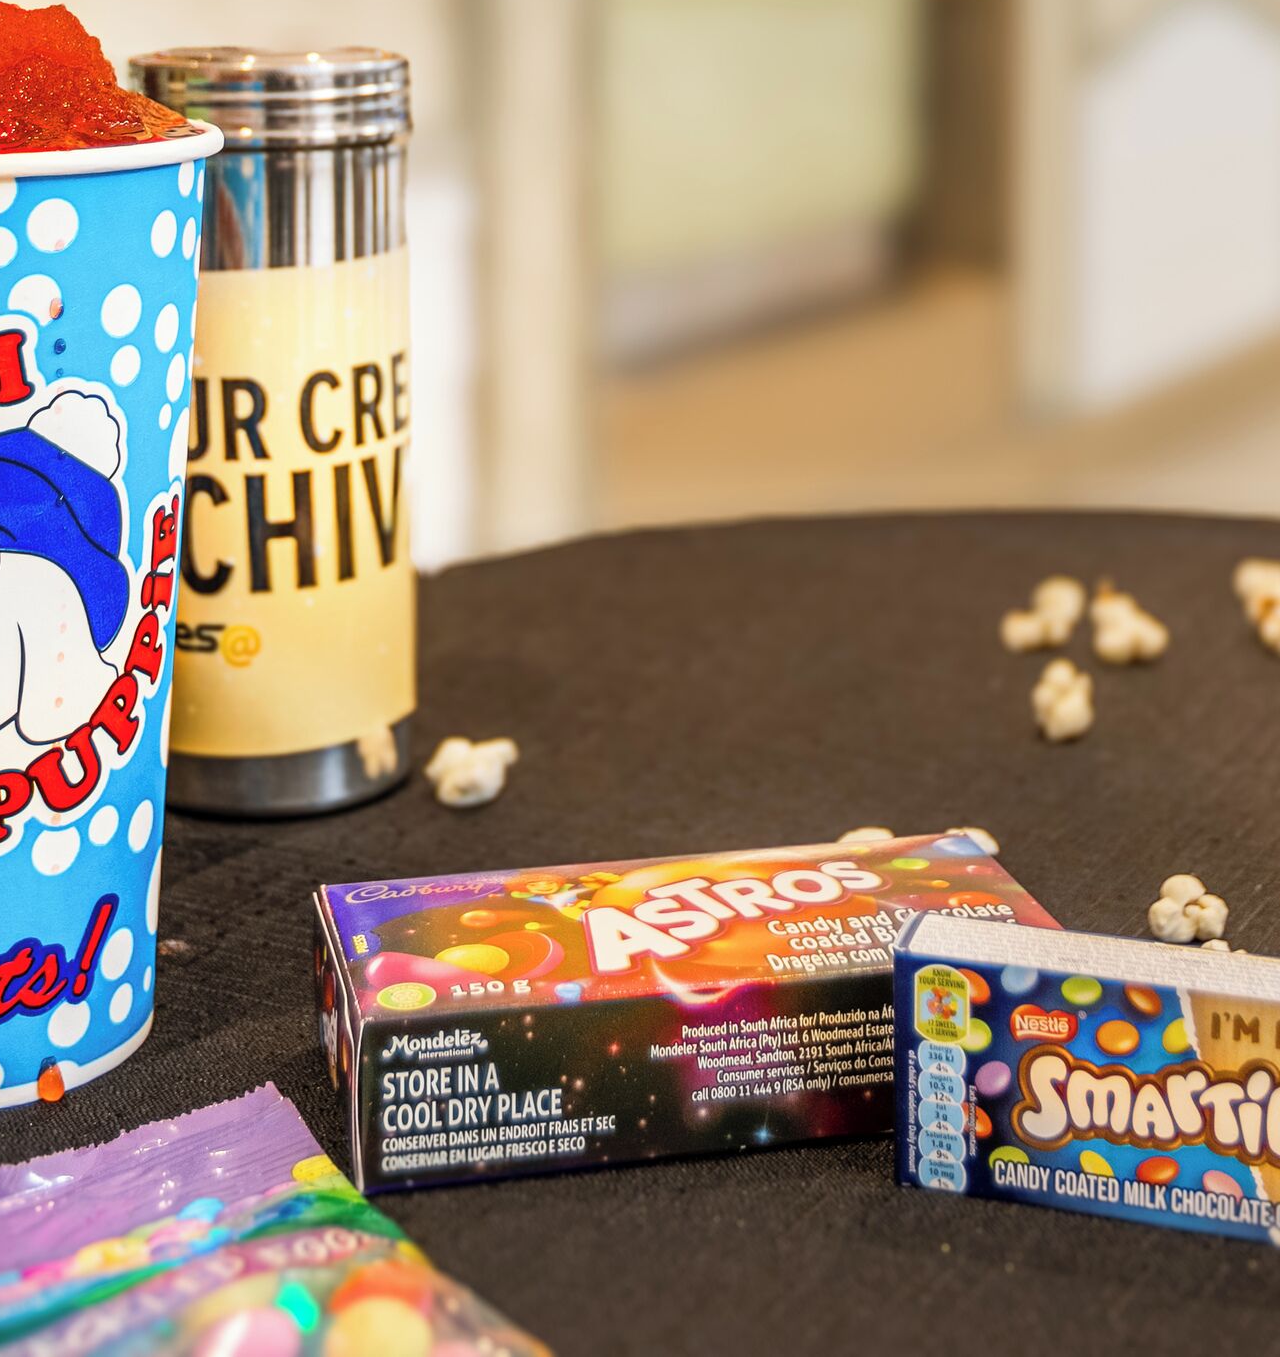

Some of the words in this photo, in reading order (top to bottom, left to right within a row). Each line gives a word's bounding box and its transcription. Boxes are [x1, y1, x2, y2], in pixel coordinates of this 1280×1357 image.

[300, 352, 410, 454] CRE
[181, 445, 406, 596] CHIV
[345, 882, 485, 904] Cadbury
[584, 861, 882, 973] ASTROS
[768, 915, 844, 936] Candy
[847, 910, 893, 930] and
[789, 929, 873, 951] coated
[850, 947, 889, 963] com
[451, 980, 505, 996] 150
[513, 979, 531, 993] g
[919, 976, 936, 985] YOUR
[938, 978, 965, 989] SERVING
[932, 969, 951, 978] KNOW
[682, 1022, 726, 1039] Produced
[729, 1021, 738, 1034] in
[740, 1018, 768, 1033] South
[770, 1015, 797, 1030] Africa
[799, 1013, 817, 1027] for/
[819, 1008, 866, 1025] Produzido
[868, 1010, 879, 1020] na
[1210, 1011, 1261, 1044] I'M
[418, 1046, 474, 1060] International
[651, 1043, 697, 1058] Mondelez
[700, 1039, 727, 1053] South
[729, 1036, 756, 1050] Africa
[758, 1032, 781, 1049] (Pty)
[783, 1031, 800, 1045] Ltd.
[802, 1030, 809, 1042] 6
[811, 1025, 863, 1043] Woodmead
[866, 1023, 894, 1037] Estate
[698, 1051, 753, 1070] Woodmead,
[755, 1049, 797, 1063] Sandton,
[799, 1045, 823, 1059] 2191
[825, 1041, 852, 1057] South
[717, 1069, 764, 1083] Consumer
[767, 1063, 804, 1078] services
[813, 1059, 852, 1074] Serviços
[854, 1056, 866, 1069] do
[383, 1067, 452, 1100] STORE
[458, 1064, 478, 1092] IN
[484, 1062, 500, 1090] A
[692, 1087, 709, 1101] call
[711, 1085, 736, 1099] 0800
[739, 1085, 750, 1097] 11
[753, 1082, 772, 1095] 444
[774, 1081, 780, 1094] 9
[782, 1077, 804, 1094] (RSA
[806, 1074, 830, 1091] only)
[839, 1071, 894, 1086] consumersa
[383, 1101, 443, 1132] COOL
[449, 1095, 493, 1126] DRY
[498, 1088, 562, 1120] PLACE
[382, 1133, 447, 1153] CONSERVER
[449, 1130, 479, 1147] DANS
[481, 1128, 497, 1142] UN
[499, 1122, 546, 1141] ENDROIT
[549, 1119, 579, 1135] FRAIS
[581, 1117, 594, 1131] ET
[596, 1115, 616, 1130] SEC
[906, 1125, 917, 1143] Daily
[382, 1151, 447, 1171] CONSERVAR
[449, 1149, 466, 1164] EM
[468, 1144, 504, 1161] LUGAR
[506, 1141, 546, 1158] FRESCO
[549, 1139, 555, 1153] E
[557, 1136, 586, 1152] SECO
[908, 1144, 916, 1173] Amount
[993, 1159, 1051, 1195] CANDY
[1053, 1168, 1119, 1205] COATED
[1123, 1177, 1168, 1215] MILK
[1170, 1183, 1273, 1230] CHOCOLATE
